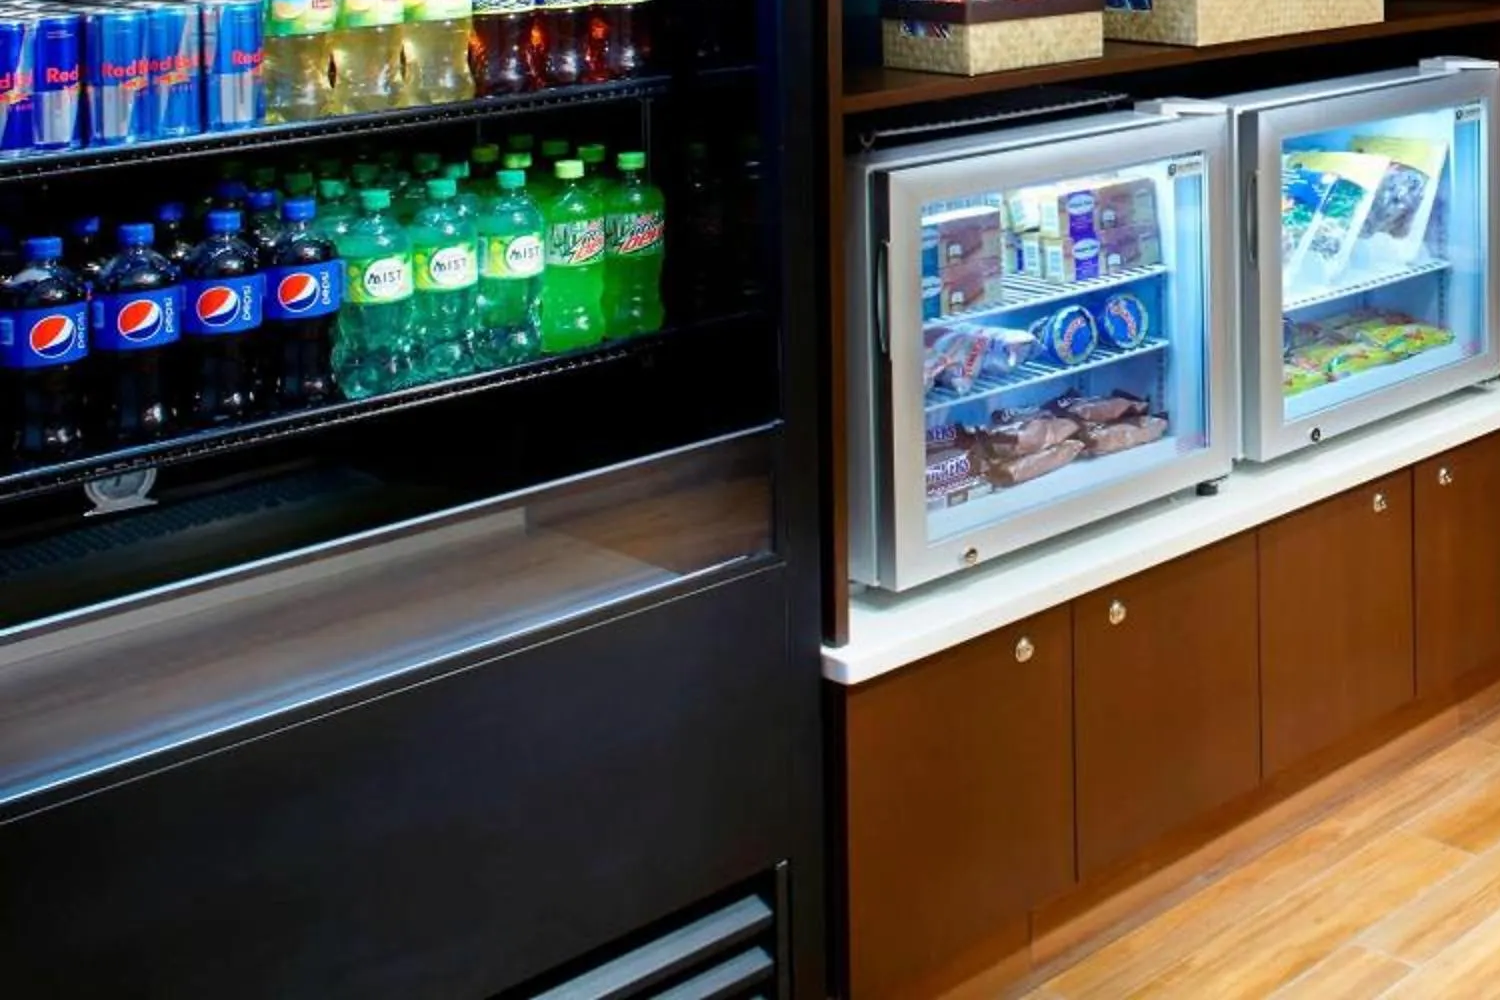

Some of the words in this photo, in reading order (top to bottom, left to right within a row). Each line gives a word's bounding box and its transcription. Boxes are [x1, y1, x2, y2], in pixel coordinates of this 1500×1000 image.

[46, 64, 79, 83] Red
[242, 285, 251, 321] pepsi
[320, 271, 331, 305] pepsi
[164, 296, 175, 334] pepsi
